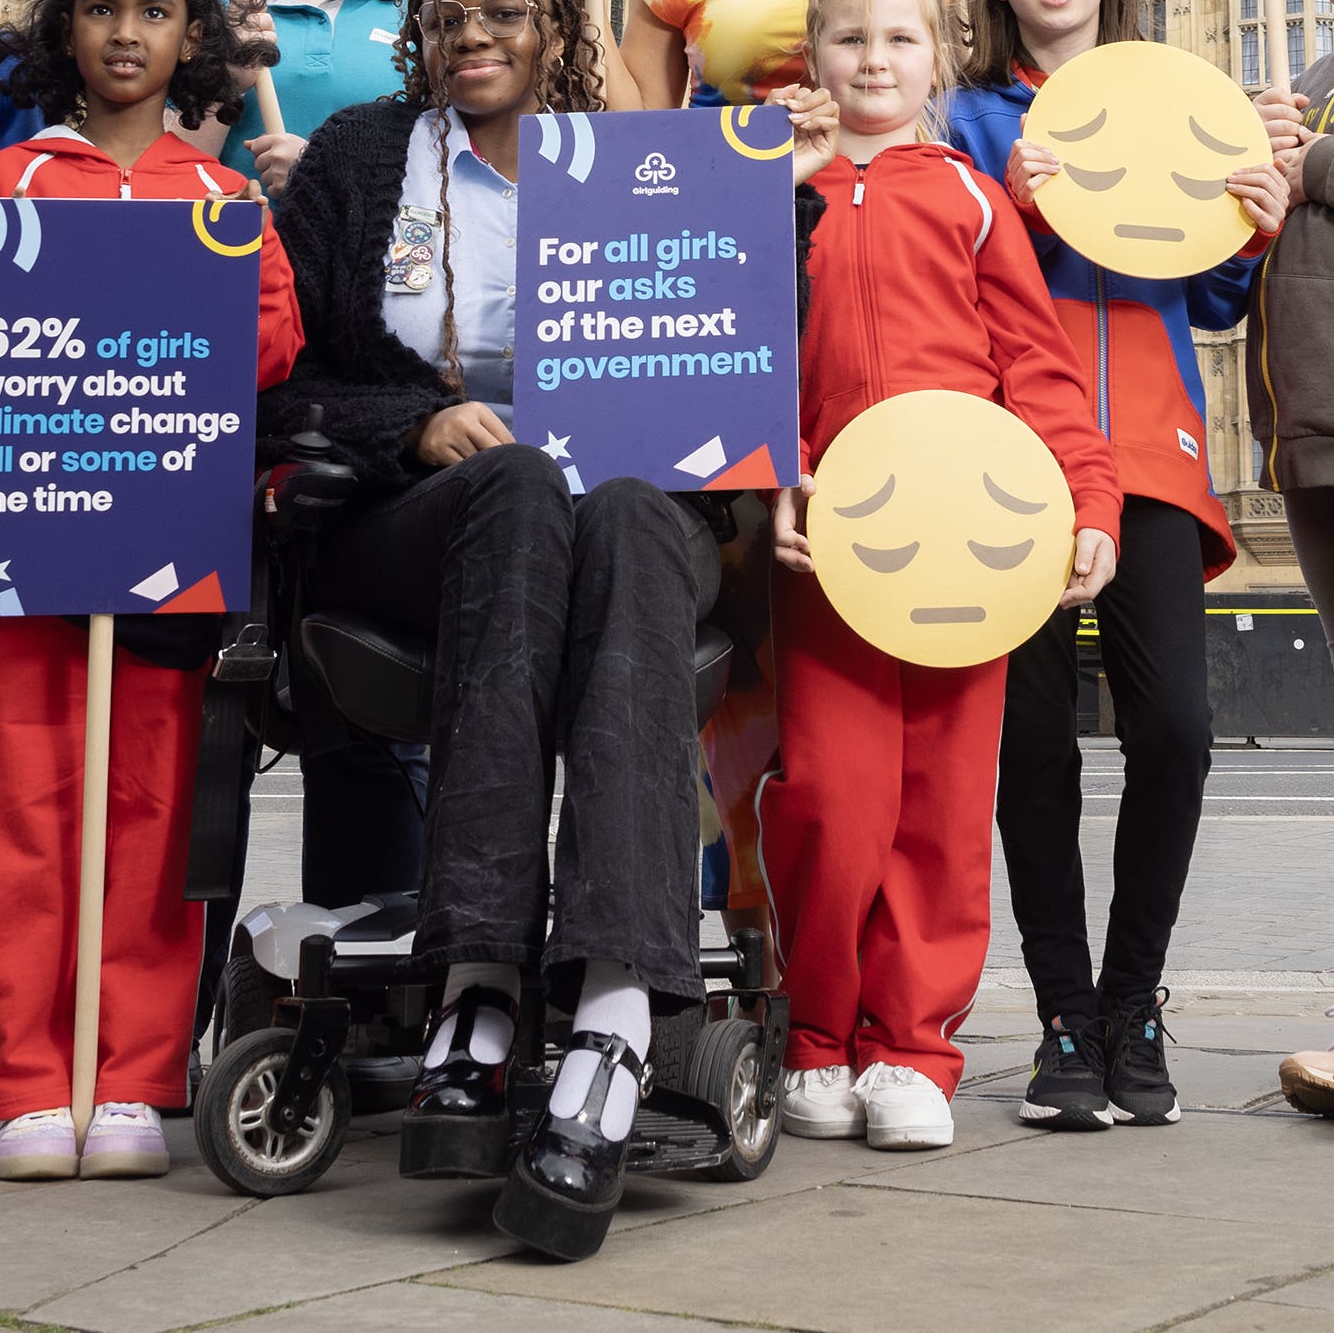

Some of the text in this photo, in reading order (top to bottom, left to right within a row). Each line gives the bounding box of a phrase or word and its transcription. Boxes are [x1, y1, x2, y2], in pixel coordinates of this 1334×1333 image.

[632, 185, 679, 196] Girlguiding
[538, 230, 747, 270] For all girls,
[537, 271, 696, 303] our asks
[536, 308, 736, 342] of the next
[96, 331, 131, 359] of
[136, 331, 210, 367] girls
[83, 369, 186, 397] about
[536, 345, 772, 391] government
[110, 407, 240, 443] change
[19, 448, 56, 472] or
[61, 446, 157, 472] some
[162, 444, 196, 471] of
[33, 483, 112, 512] time
